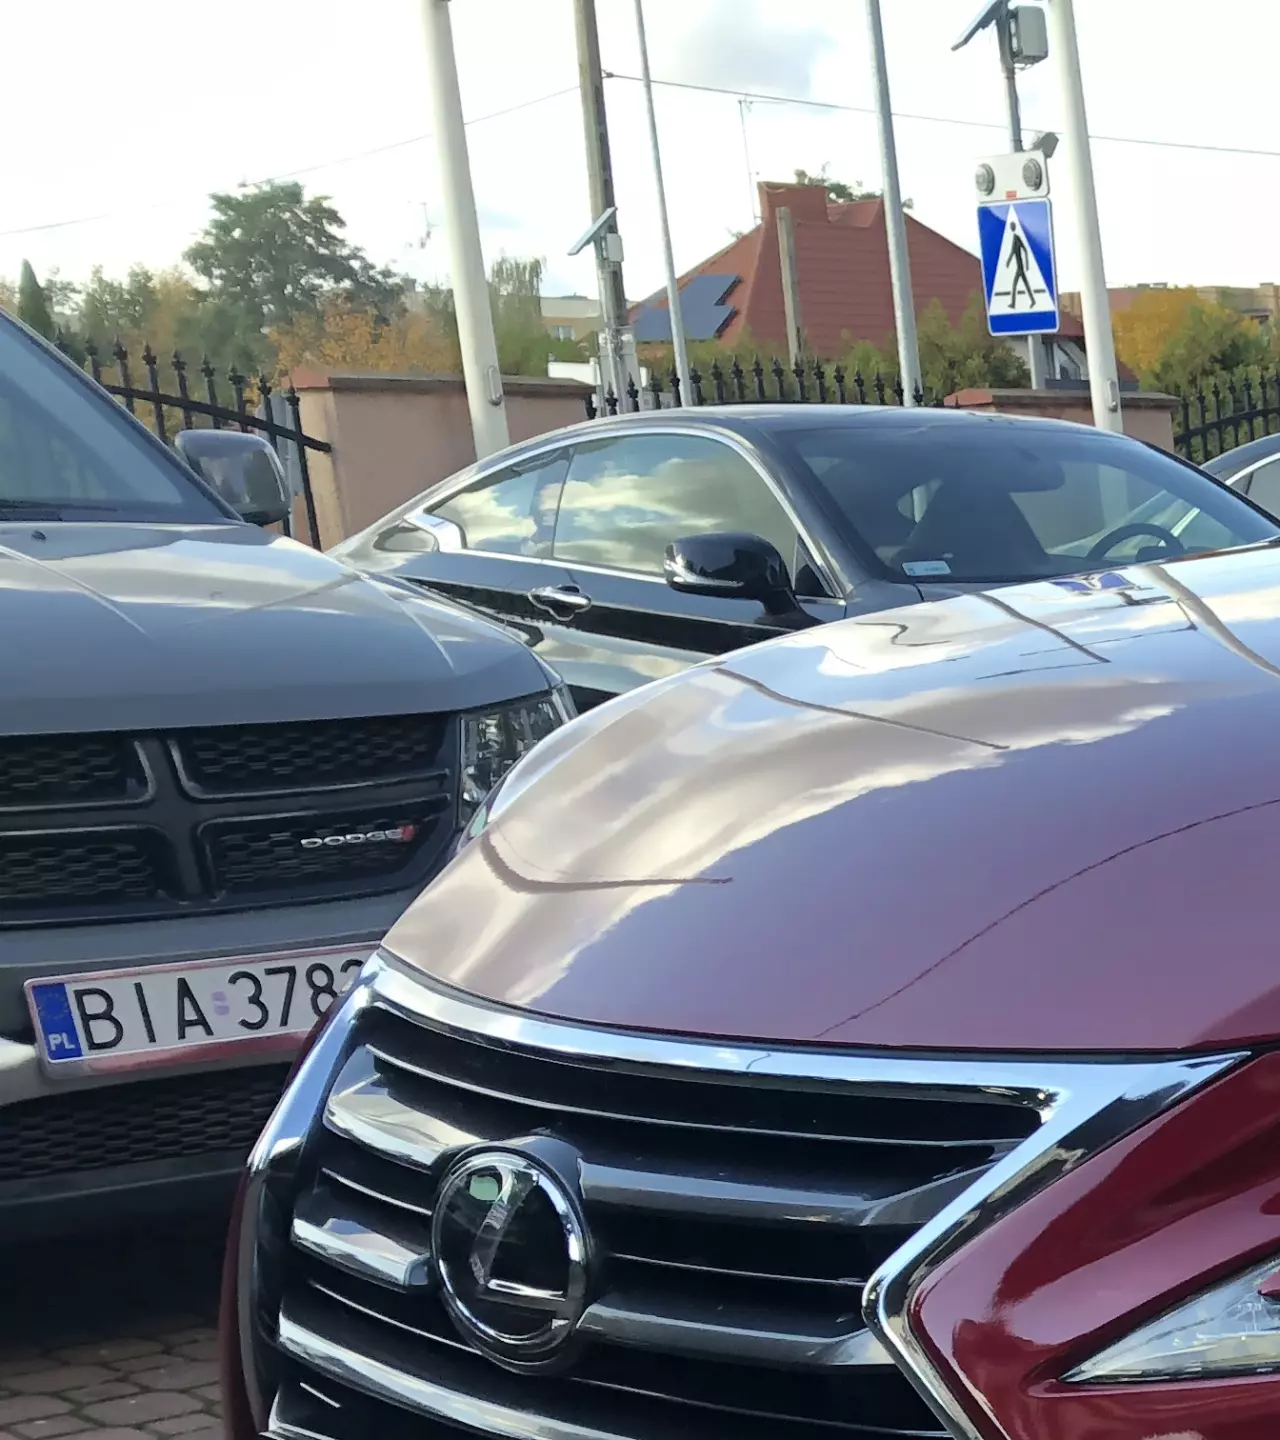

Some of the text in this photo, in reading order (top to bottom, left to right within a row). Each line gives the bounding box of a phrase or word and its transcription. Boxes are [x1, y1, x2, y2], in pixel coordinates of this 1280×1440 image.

[300, 830, 404, 848] DODGE
[73, 977, 214, 1051] BIA
[48, 1032, 76, 1051] PL
